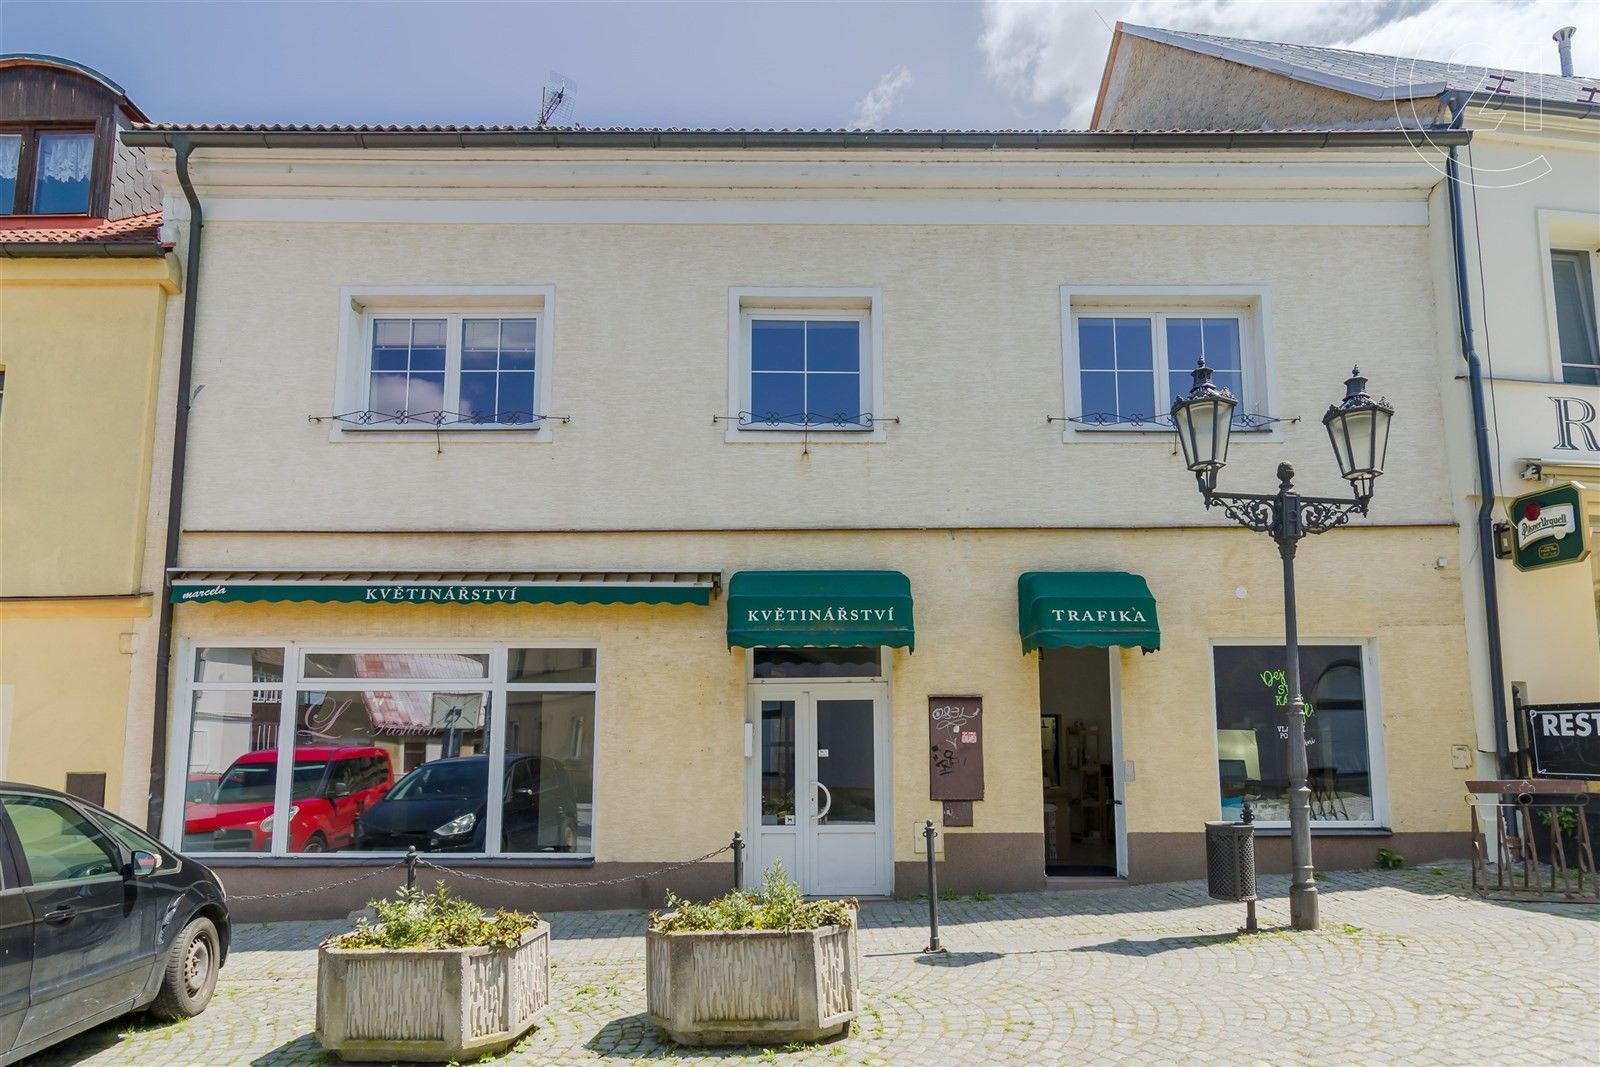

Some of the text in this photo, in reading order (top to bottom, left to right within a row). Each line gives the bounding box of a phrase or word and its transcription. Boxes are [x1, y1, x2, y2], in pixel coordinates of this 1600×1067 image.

[1521, 513, 1567, 540] Pilsner Urquell
[182, 585, 227, 600] marcela
[365, 586, 517, 600] KVĚTINÁŘSTVÍ
[748, 607, 895, 621] KVĚTINÁŘSTVÍ
